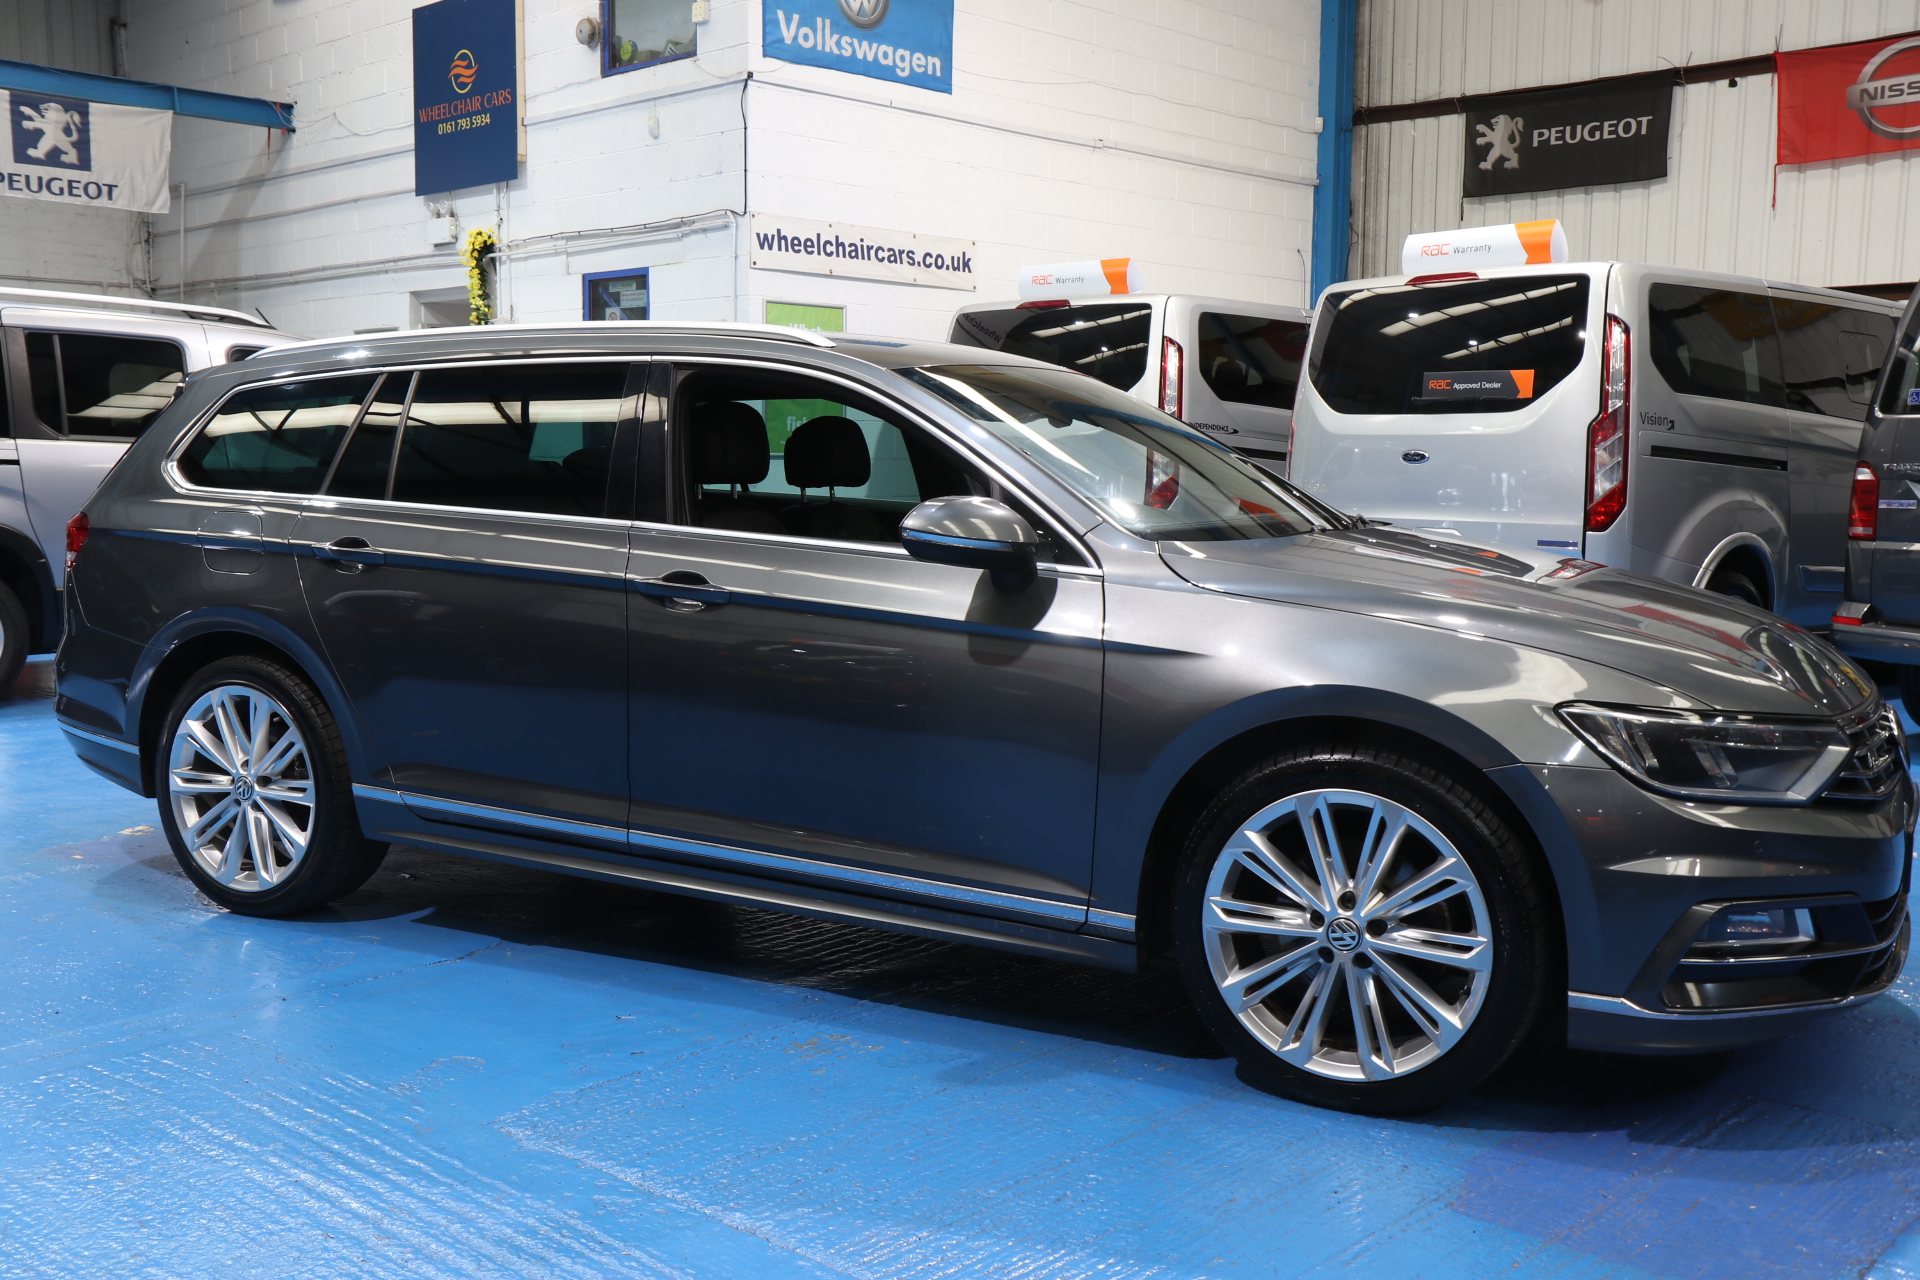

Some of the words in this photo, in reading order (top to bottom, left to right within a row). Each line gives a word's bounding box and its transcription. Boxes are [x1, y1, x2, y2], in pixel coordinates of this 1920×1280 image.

[777, 9, 942, 77] Volkswagen
[418, 95, 482, 123] WHEELCHAIR
[484, 88, 513, 109] CARS
[437, 121, 455, 135] 0161
[457, 117, 471, 131] 793
[472, 113, 491, 128] 5934
[1532, 115, 1653, 147] PEUGEOT
[755, 228, 973, 274] wheelchaircars.co.uk
[1453, 243, 1492, 255] Warranty
[1055, 276, 1085, 285] Warranty
[1452, 381, 1480, 391] Approved
[1481, 381, 1502, 389] Dealer
[1639, 411, 1669, 427] Vision
